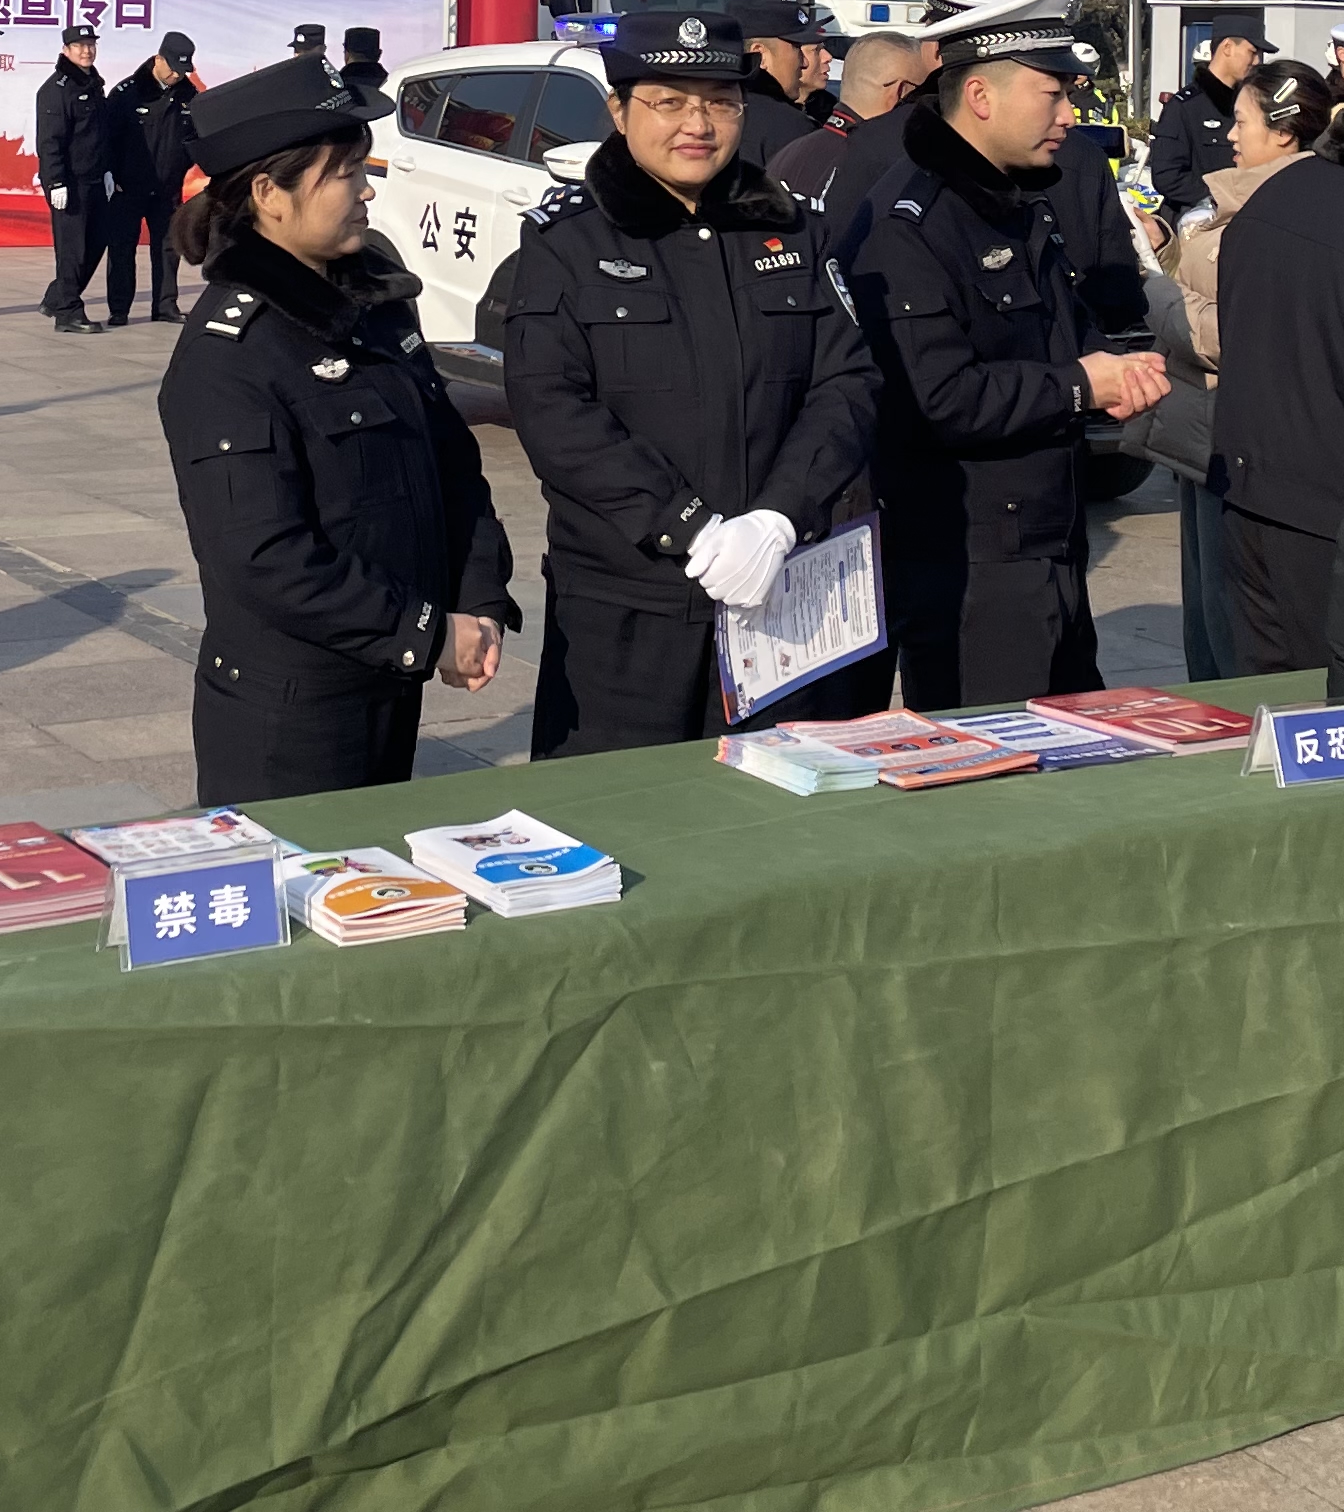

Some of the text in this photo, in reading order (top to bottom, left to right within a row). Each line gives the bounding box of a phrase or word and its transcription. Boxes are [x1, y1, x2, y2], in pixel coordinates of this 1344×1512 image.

[419, 201, 478, 262] 公安
[754, 252, 802, 272] 021897
[153, 883, 251, 940] 禁毒
